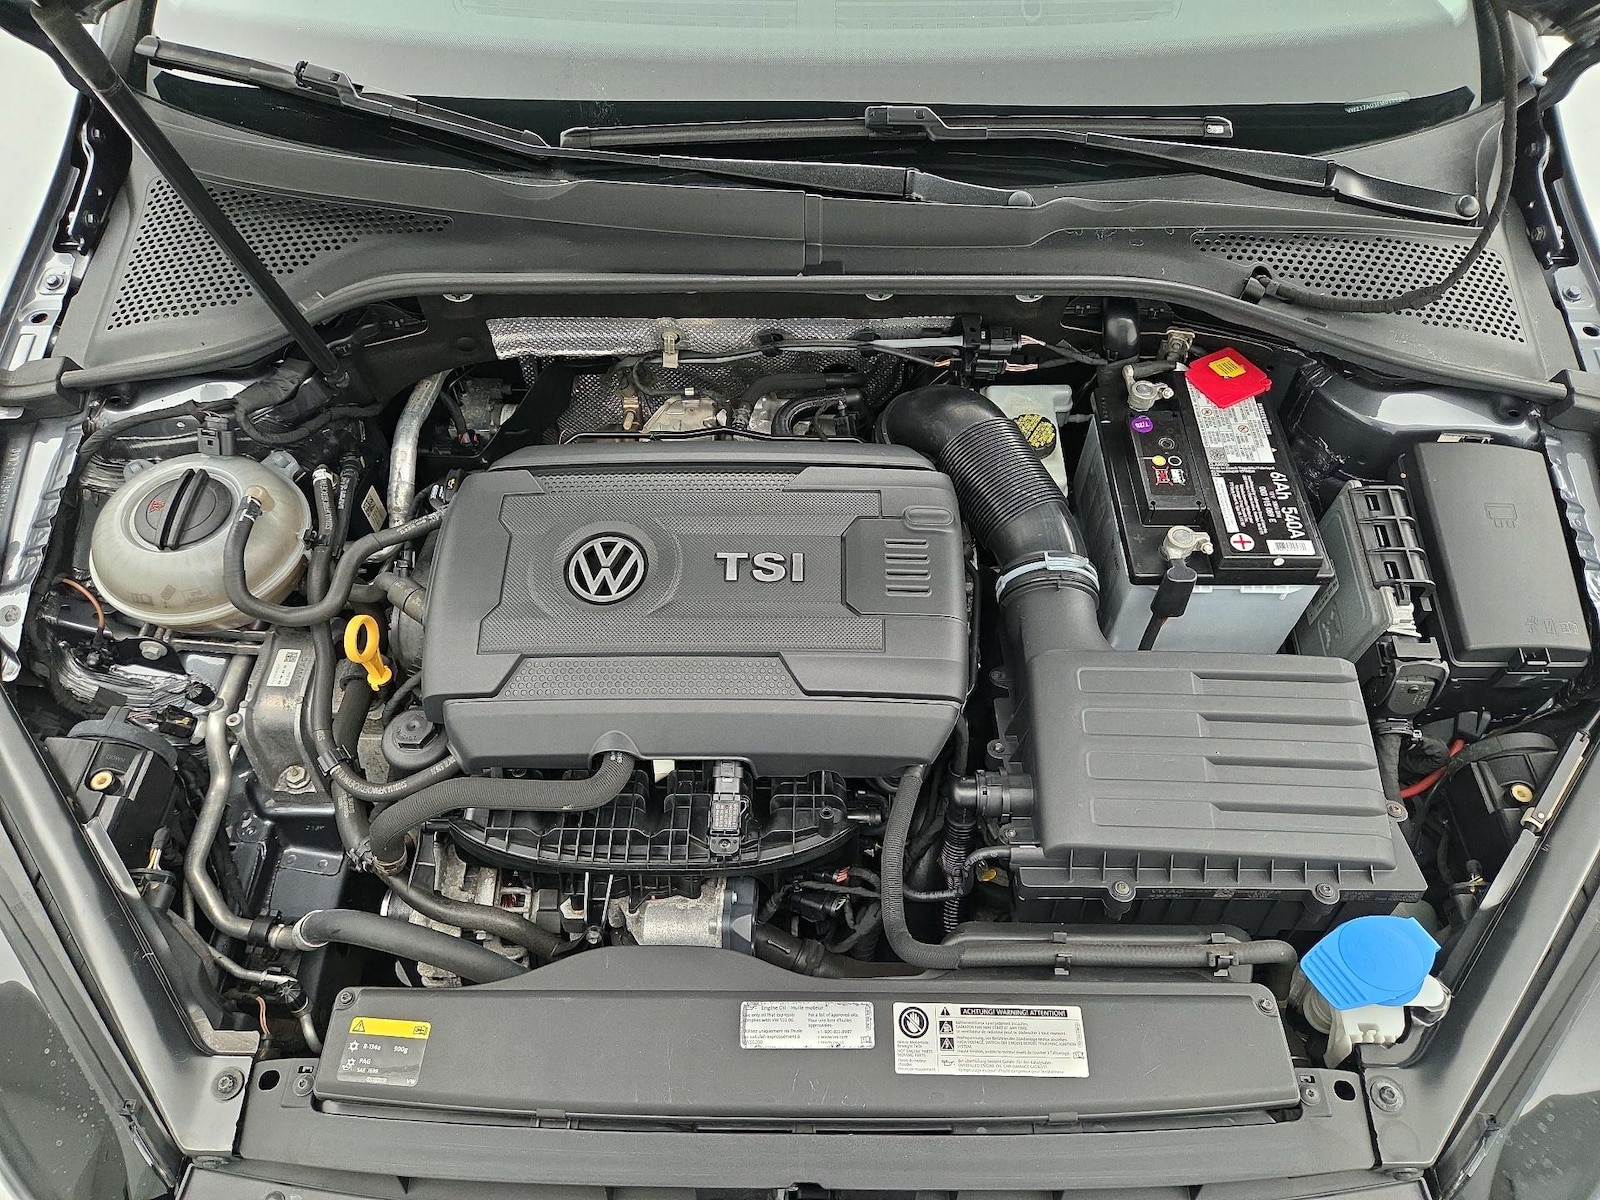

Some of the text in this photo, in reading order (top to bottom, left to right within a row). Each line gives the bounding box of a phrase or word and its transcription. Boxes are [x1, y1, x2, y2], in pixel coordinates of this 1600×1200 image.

[1270, 472, 1292, 500] 61Ah
[1281, 507, 1306, 539] 540A
[715, 552, 805, 583] TSI
[996, 1008, 1029, 1016] WARNING!
[1030, 1009, 1066, 1017] ATTENTION!
[393, 1045, 409, 1055] 500g
[358, 1057, 371, 1065] PAG
